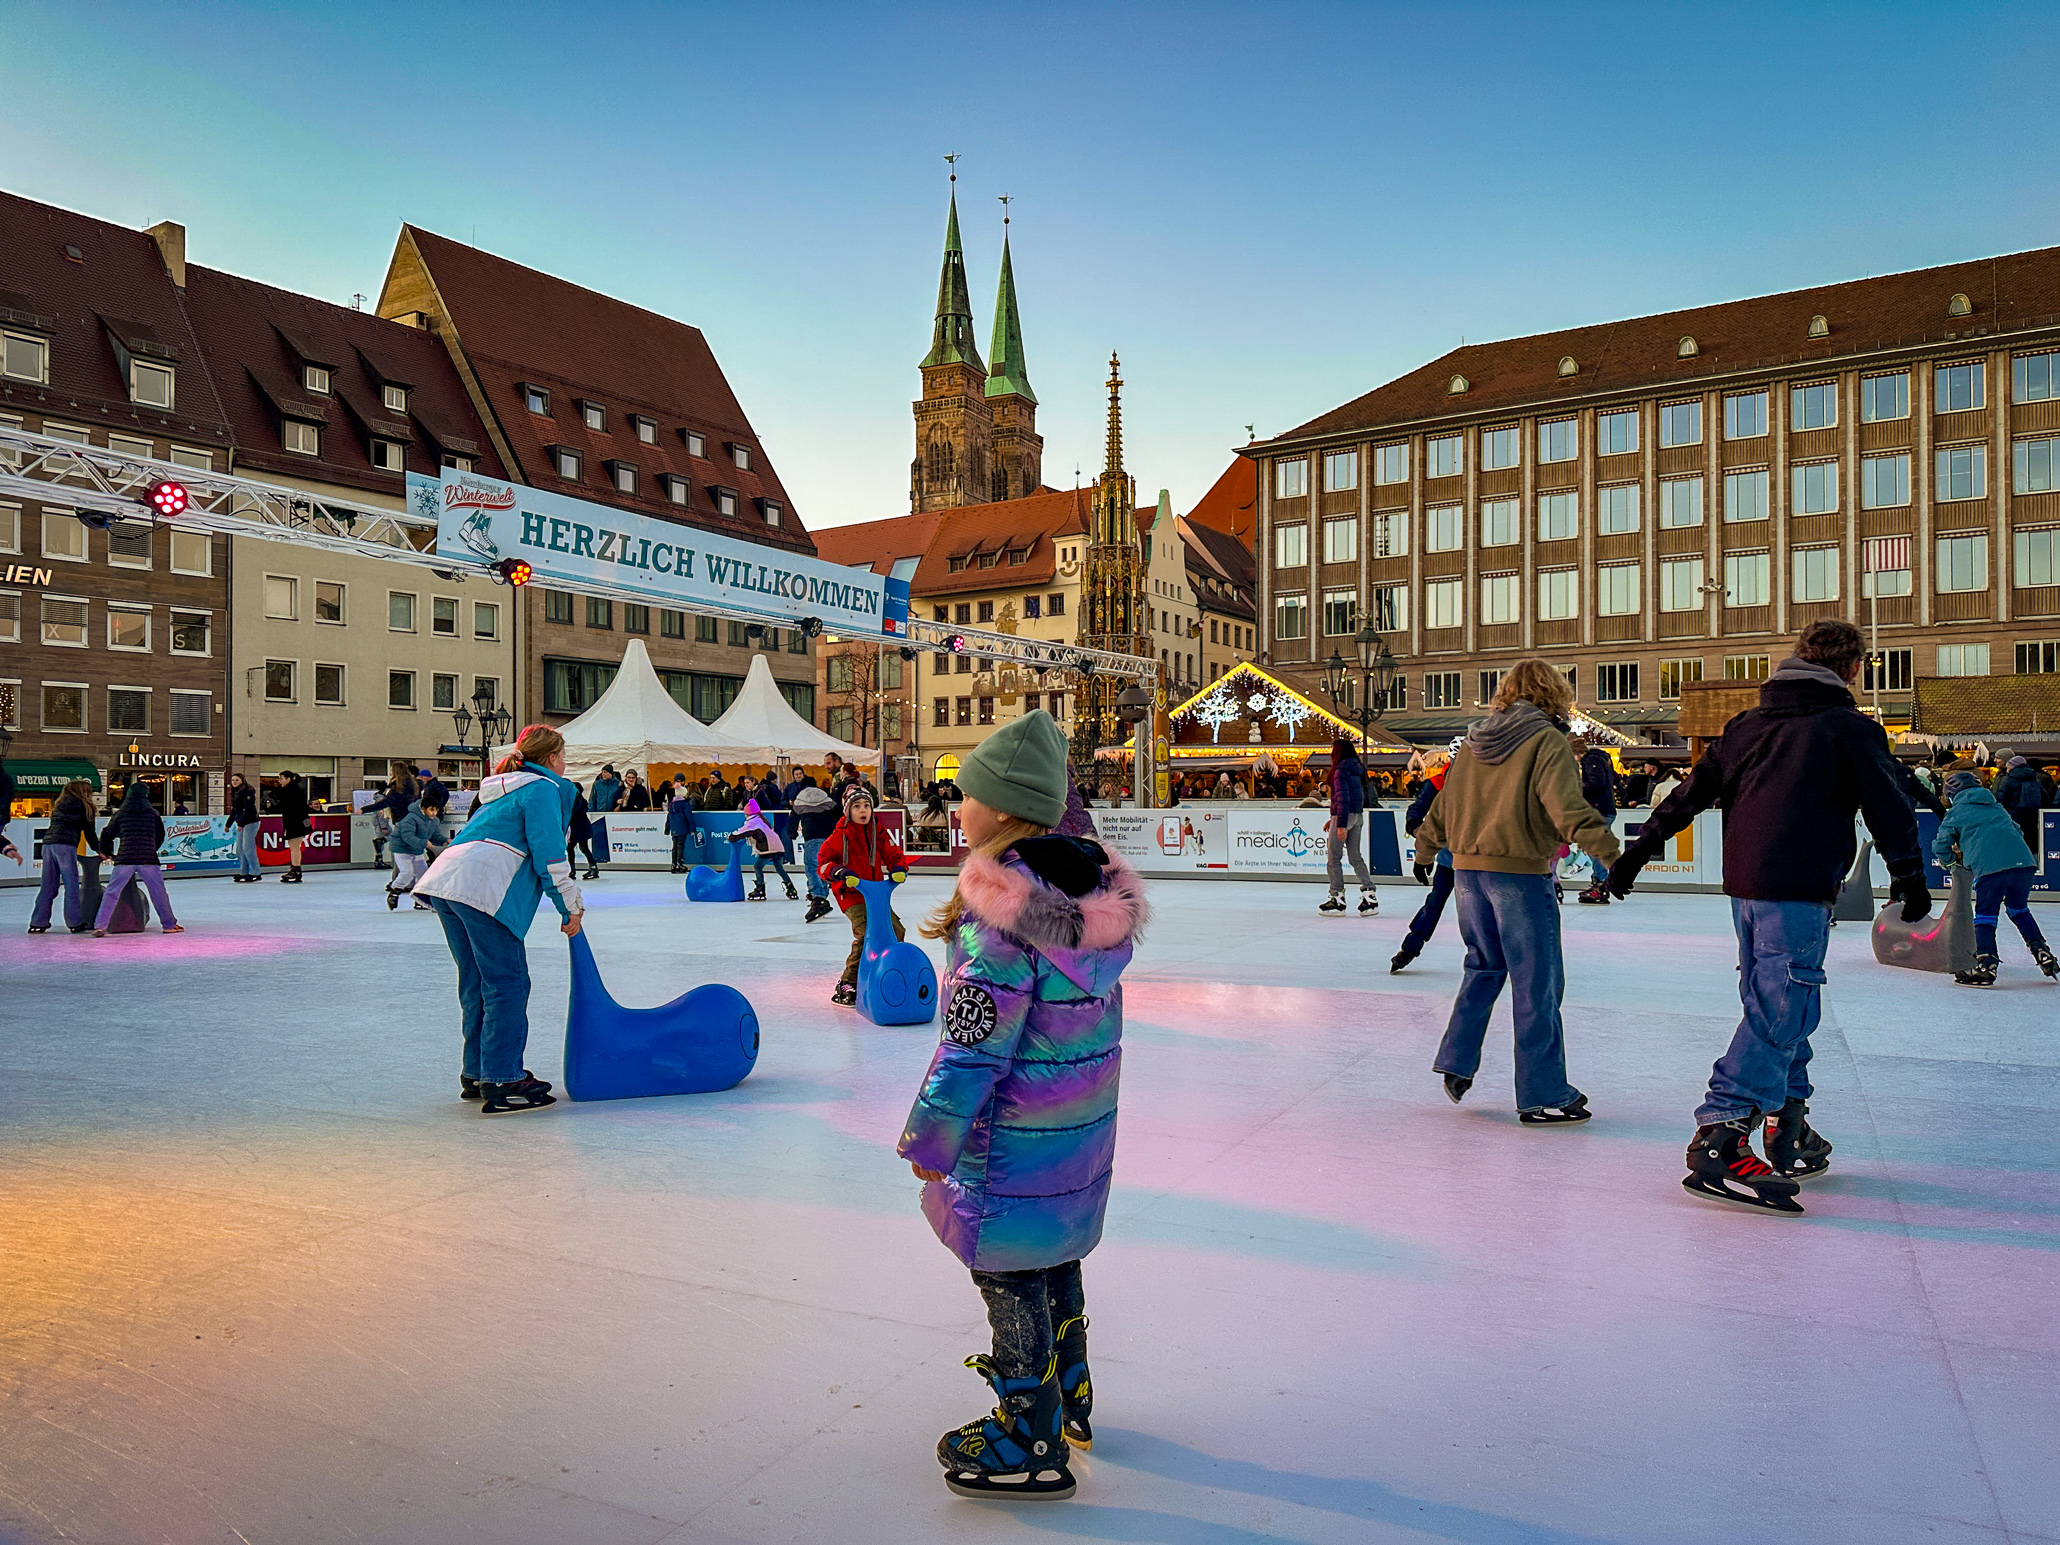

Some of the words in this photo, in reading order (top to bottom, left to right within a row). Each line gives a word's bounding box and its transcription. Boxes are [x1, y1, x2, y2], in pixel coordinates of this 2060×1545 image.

[444, 484, 515, 505] Winterwelt
[519, 511, 695, 578] HERZLICH
[705, 553, 879, 615] WILLKOMMEN
[0, 564, 52, 586] IEN
[119, 754, 200, 767] LINCURA
[1120, 816, 1148, 824] Mobilität
[1236, 834, 1289, 848] medic
[1645, 865, 1680, 873] RADIO
[1682, 865, 1695, 873] N1
[961, 1003, 979, 1021] TJ
[957, 1017, 975, 1029] TSYJ
